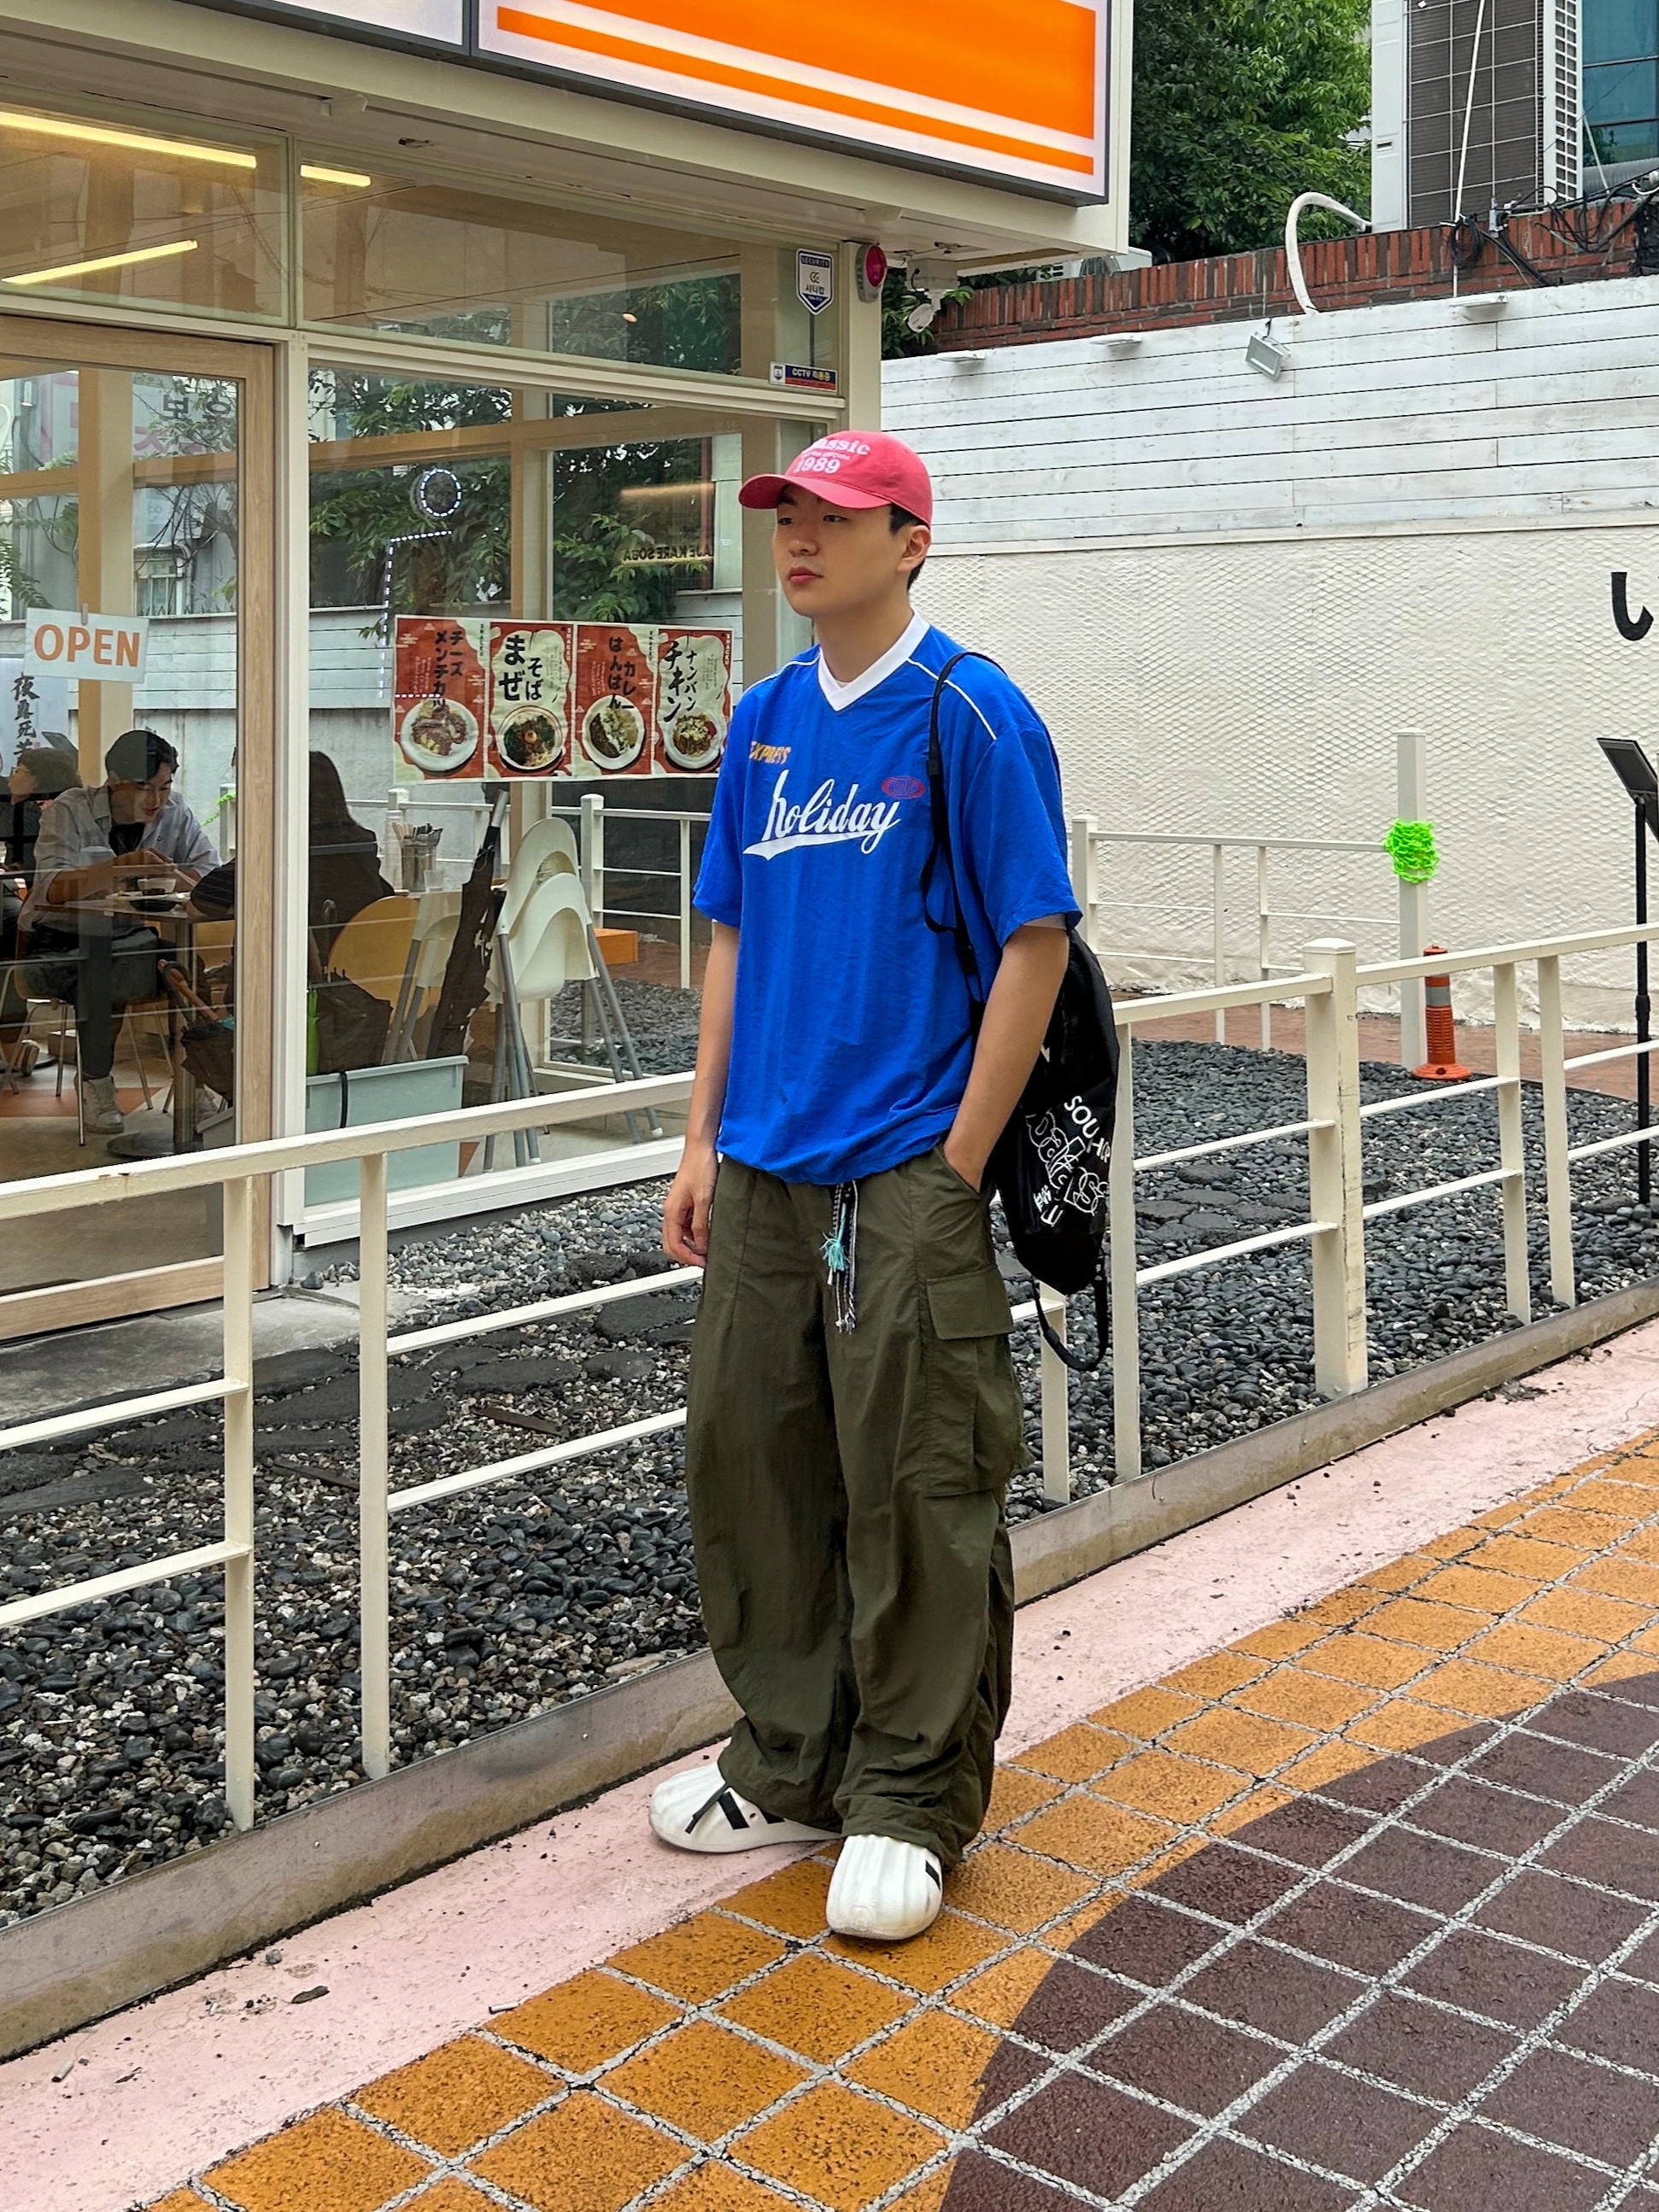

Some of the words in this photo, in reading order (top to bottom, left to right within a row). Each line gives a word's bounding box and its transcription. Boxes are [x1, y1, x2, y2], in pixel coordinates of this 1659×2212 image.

[792, 368, 811, 377] CCTV
[794, 457, 841, 474] 1989
[34, 623, 140, 667] OPEN
[664, 640, 685, 723] チキン
[761, 769, 901, 855] holiday
